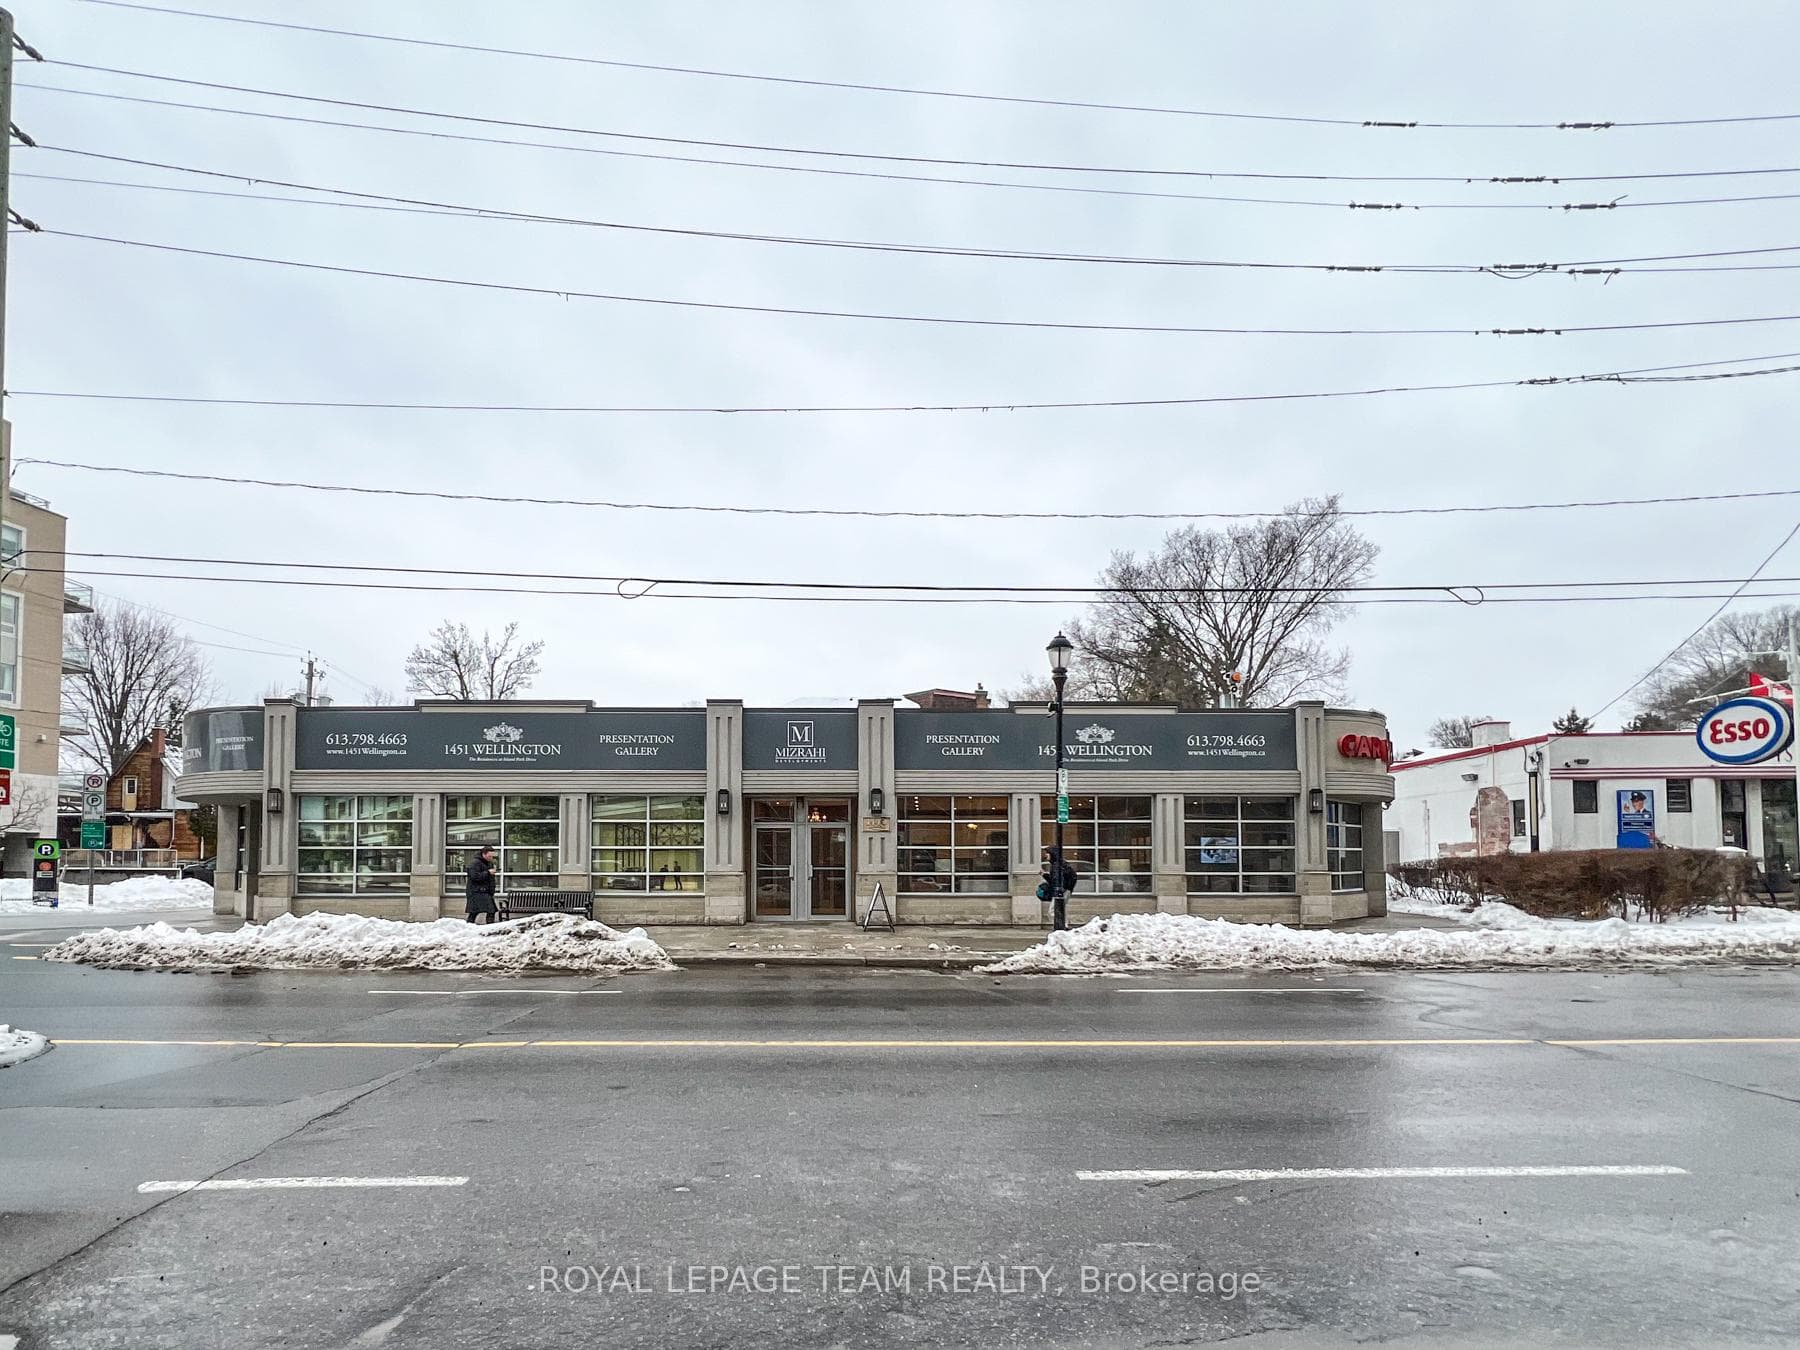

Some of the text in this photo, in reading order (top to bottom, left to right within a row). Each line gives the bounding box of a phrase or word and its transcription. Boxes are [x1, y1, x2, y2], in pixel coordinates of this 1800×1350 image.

[791, 725, 811, 742] M
[325, 733, 408, 746] 613.798.4663
[599, 734, 675, 744] PRESENTATION
[926, 734, 1000, 744] PRESENTATION
[1186, 734, 1266, 747] 613.798.4663
[326, 747, 408, 757] www.1451Wellington.ca
[444, 743, 562, 756] 1451 WELLINGTON
[614, 746, 660, 756] GALLERY
[775, 747, 826, 757] MIZRAHI
[941, 746, 985, 756] GALLERY
[1038, 744, 1153, 757] 145 WELLINGTON
[1187, 748, 1266, 758] www.1451Wellington.ca
